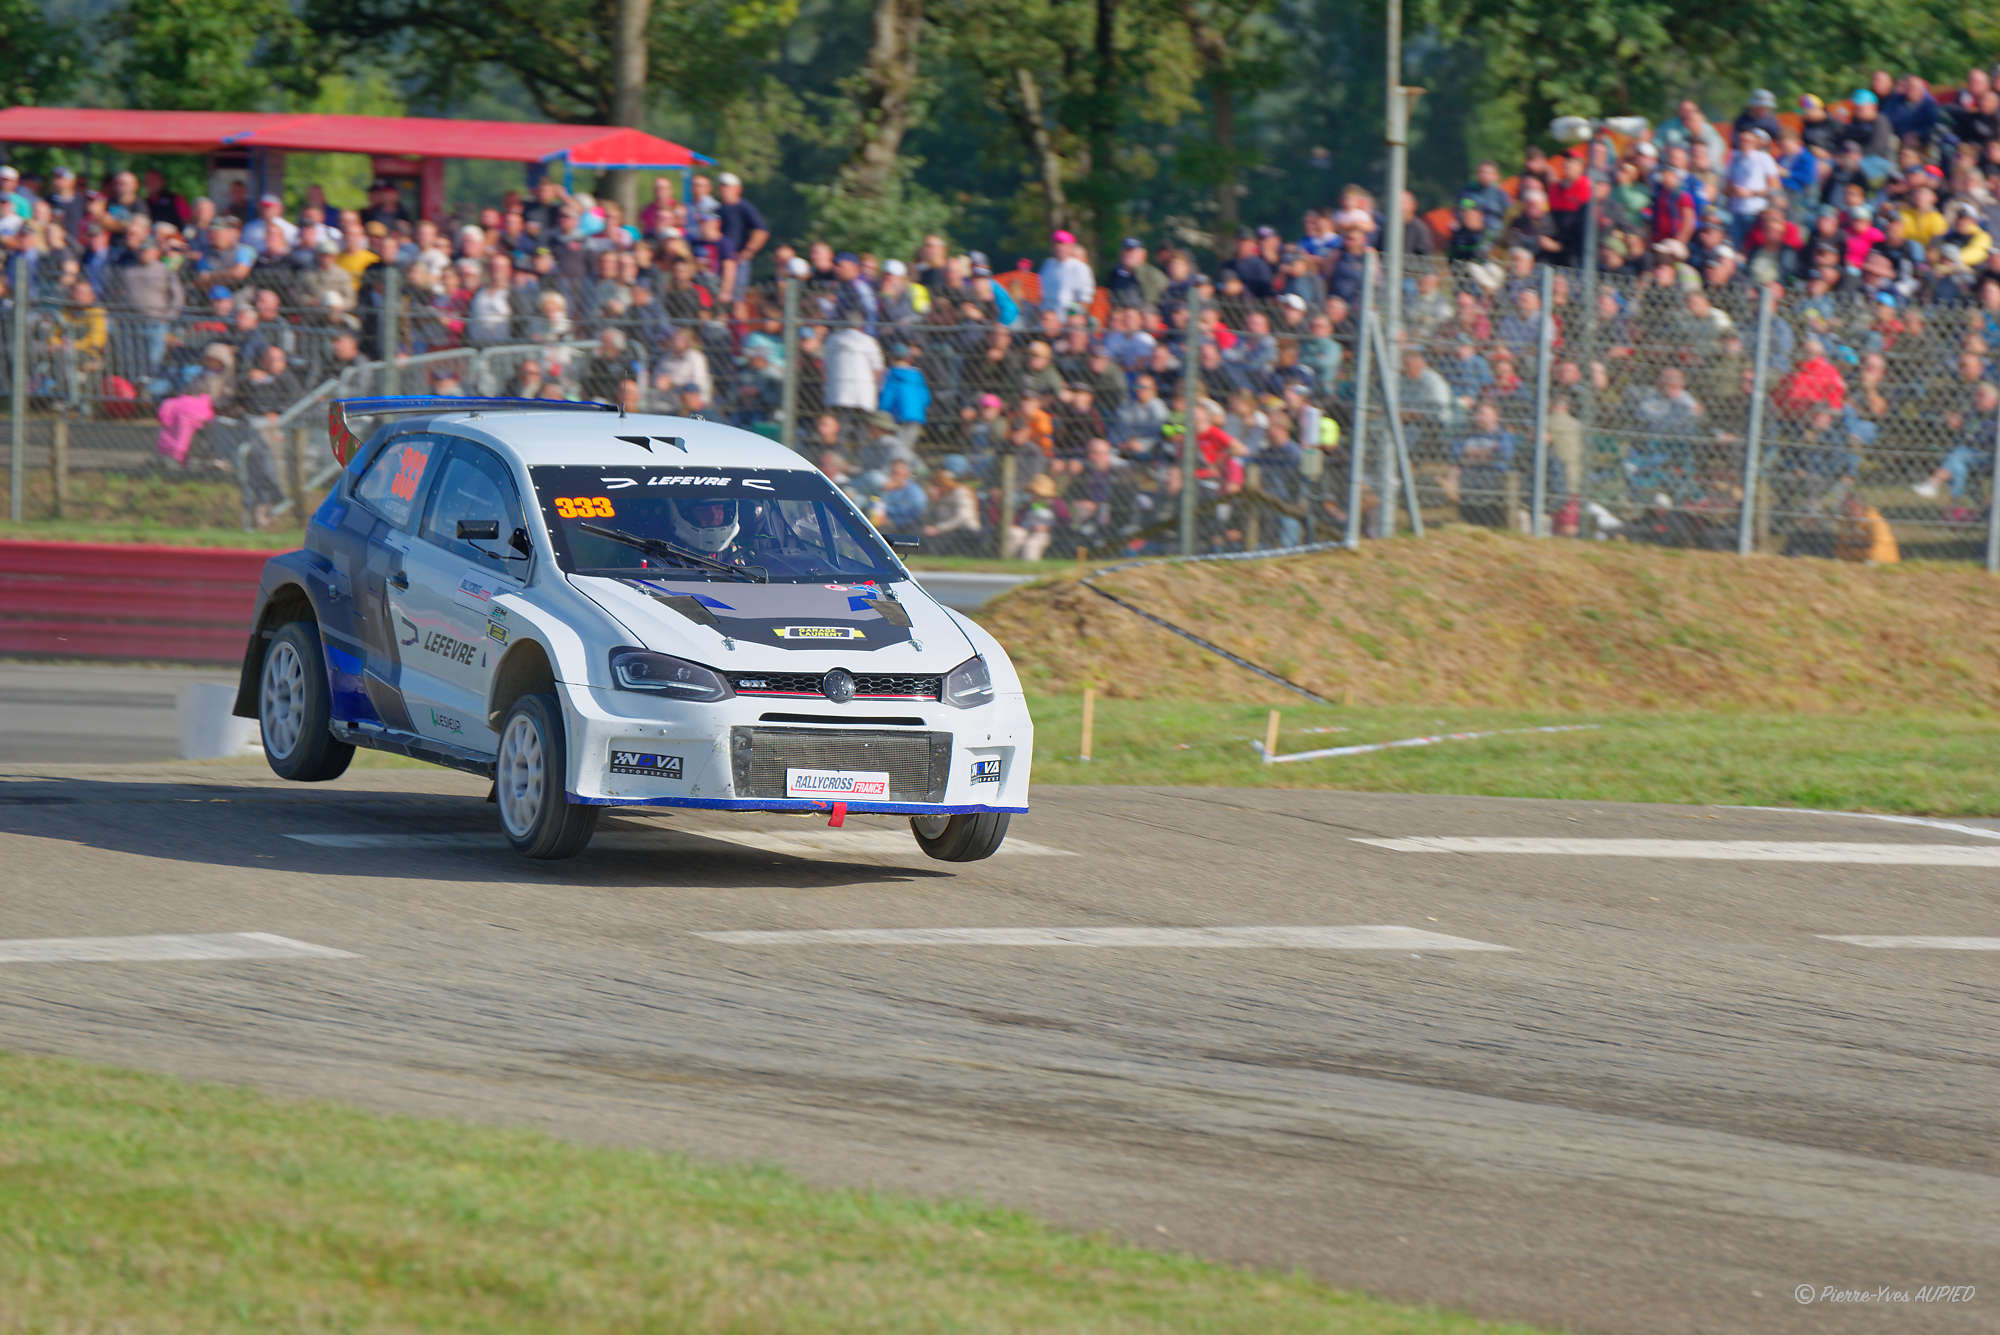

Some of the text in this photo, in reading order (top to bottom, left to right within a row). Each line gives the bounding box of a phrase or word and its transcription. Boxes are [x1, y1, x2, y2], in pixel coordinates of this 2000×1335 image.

[646, 476, 732, 486] LEFEVRE
[554, 496, 616, 518] 333
[423, 630, 477, 666] LEFEVRE
[612, 767, 681, 779] MOTORSPORT
[795, 775, 884, 793] RALLYCROSS FRANCE
